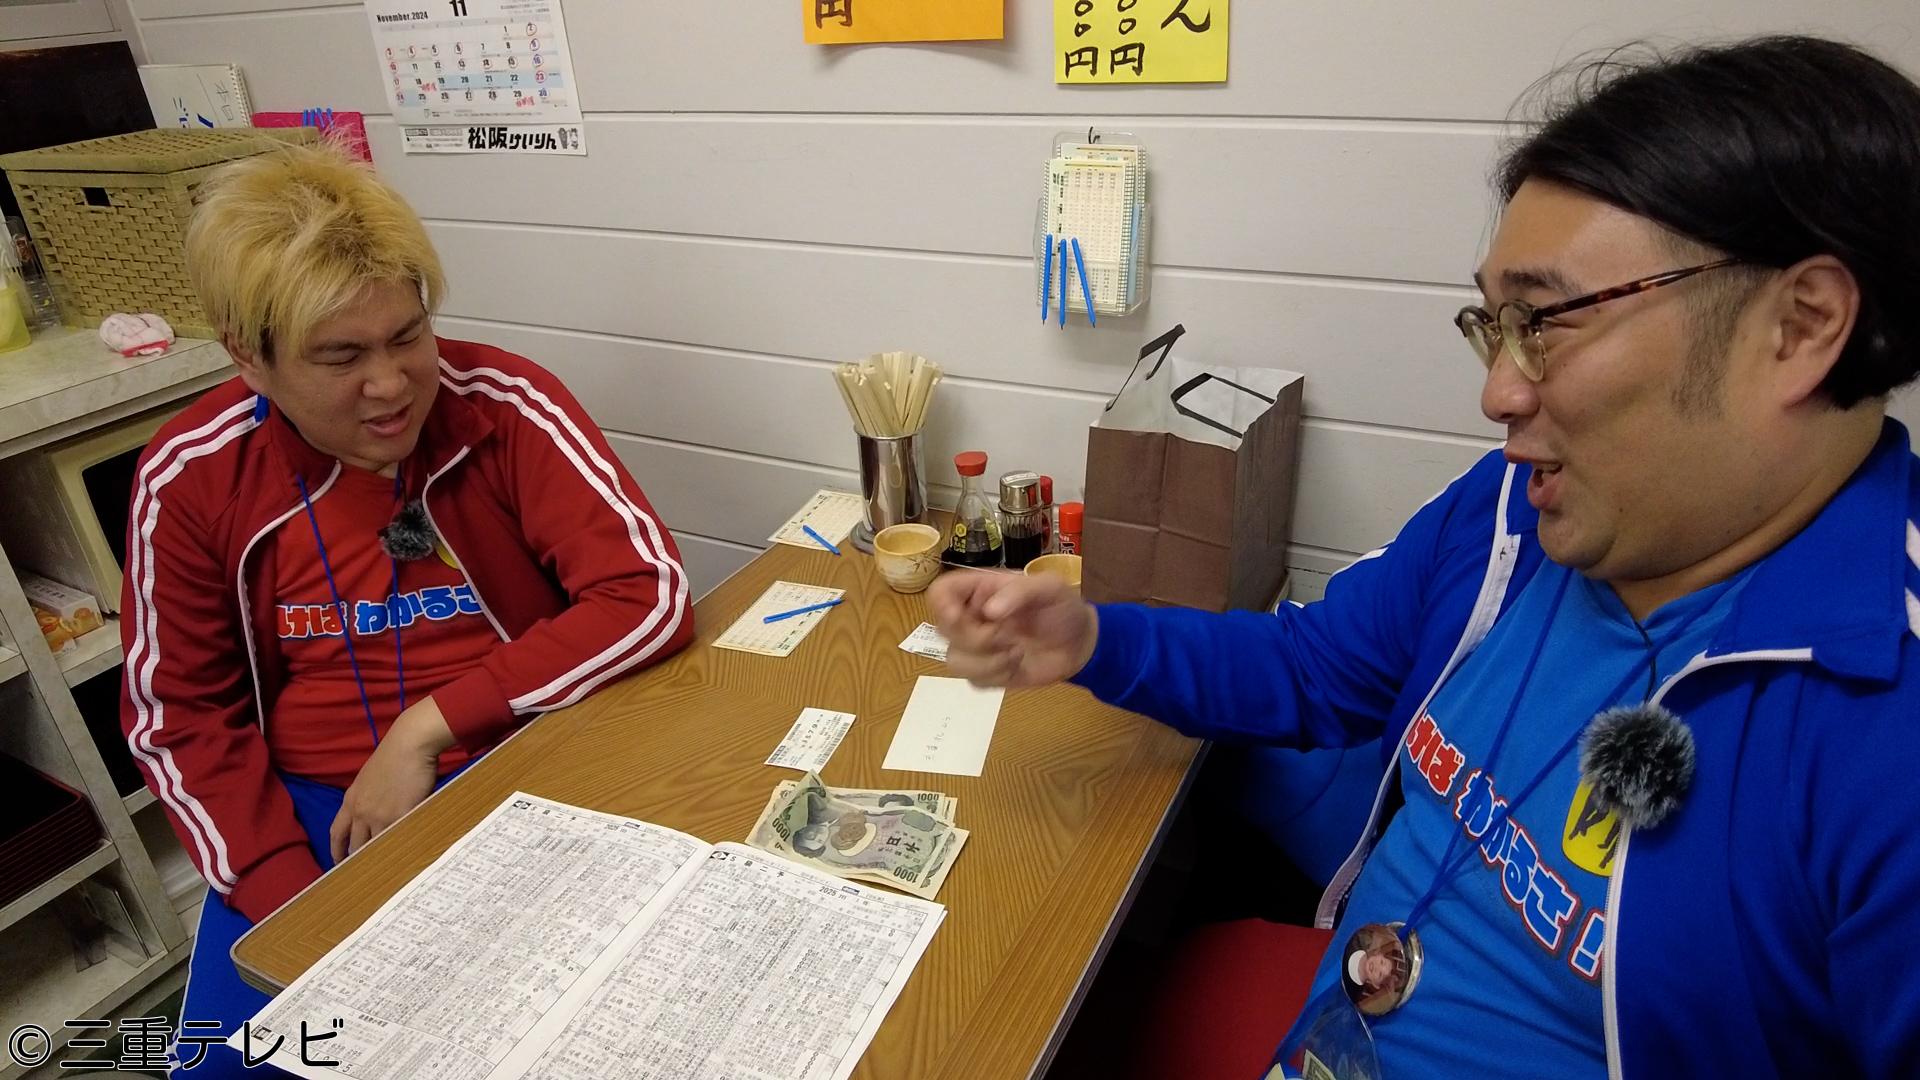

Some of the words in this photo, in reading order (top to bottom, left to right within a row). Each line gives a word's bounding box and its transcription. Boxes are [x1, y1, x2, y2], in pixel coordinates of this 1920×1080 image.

[376, 12, 410, 23] November
[411, 11, 429, 20] 2024
[449, 0, 468, 17] 11
[468, 127, 557, 150] 松阪けいりん
[772, 817, 791, 842] 1000
[893, 866, 920, 884] 1000
